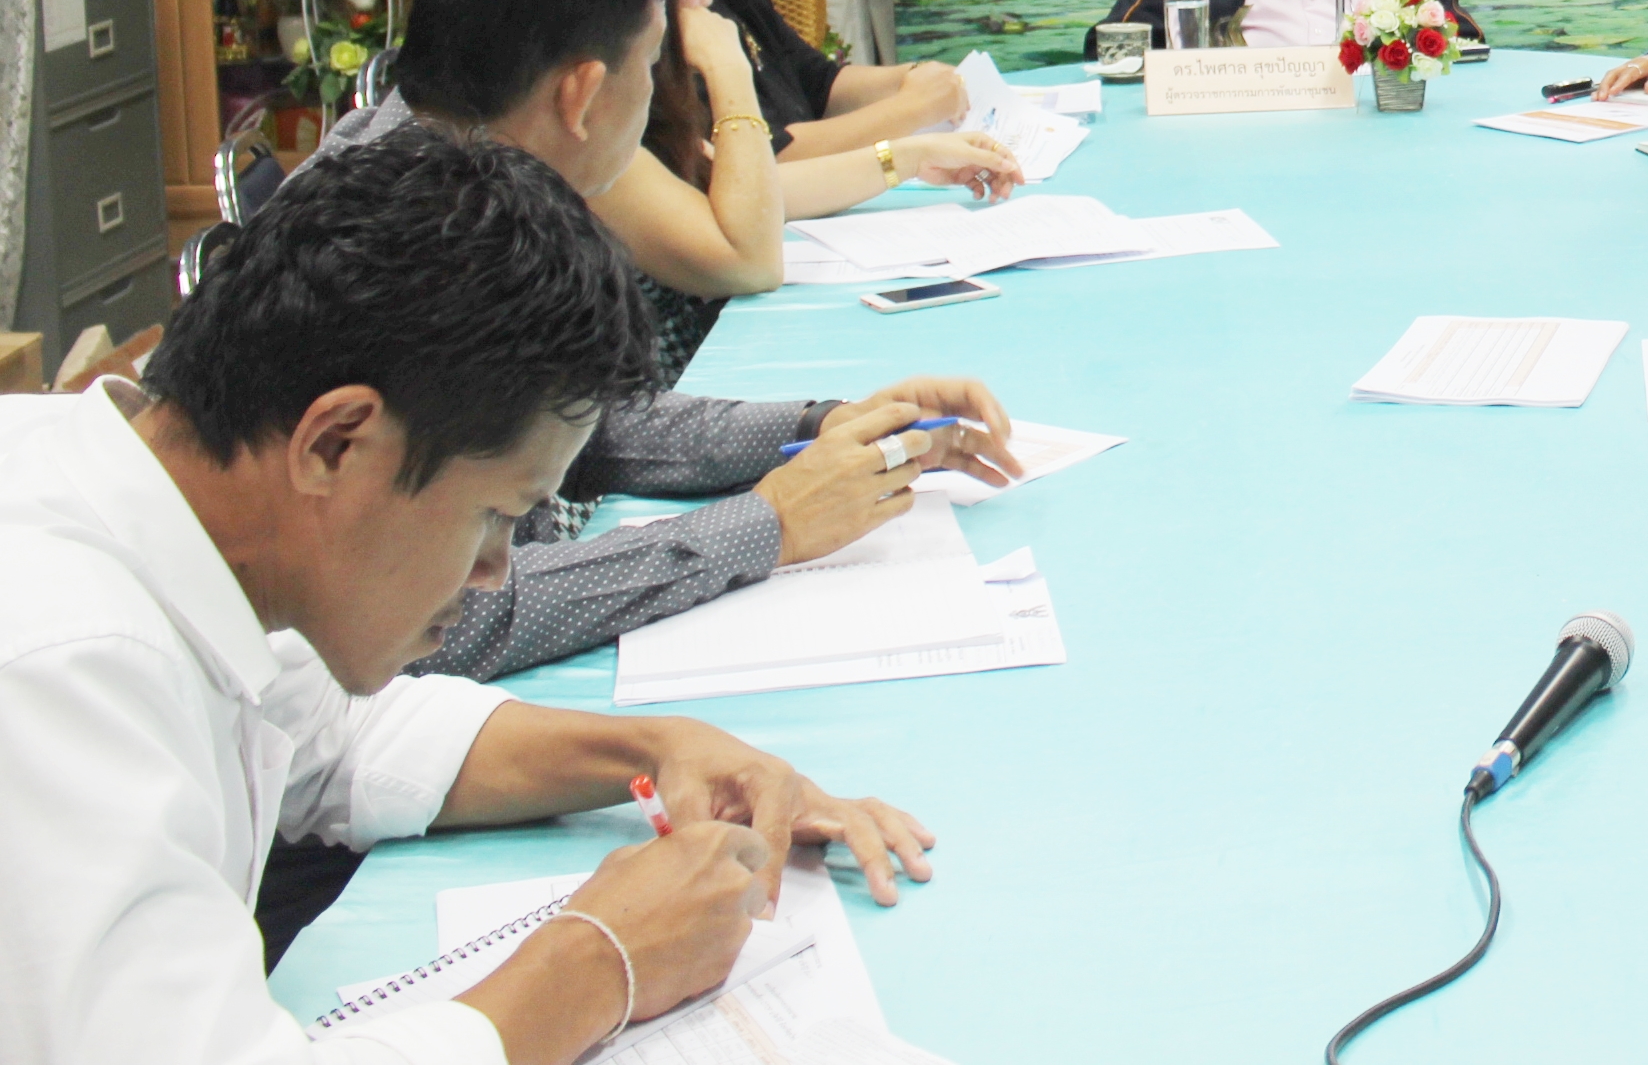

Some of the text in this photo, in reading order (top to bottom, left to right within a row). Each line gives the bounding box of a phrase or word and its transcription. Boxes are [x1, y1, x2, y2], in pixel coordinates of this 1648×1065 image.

[1172, 56, 1326, 79] ดร.ไพศาล สุขปัญญา
